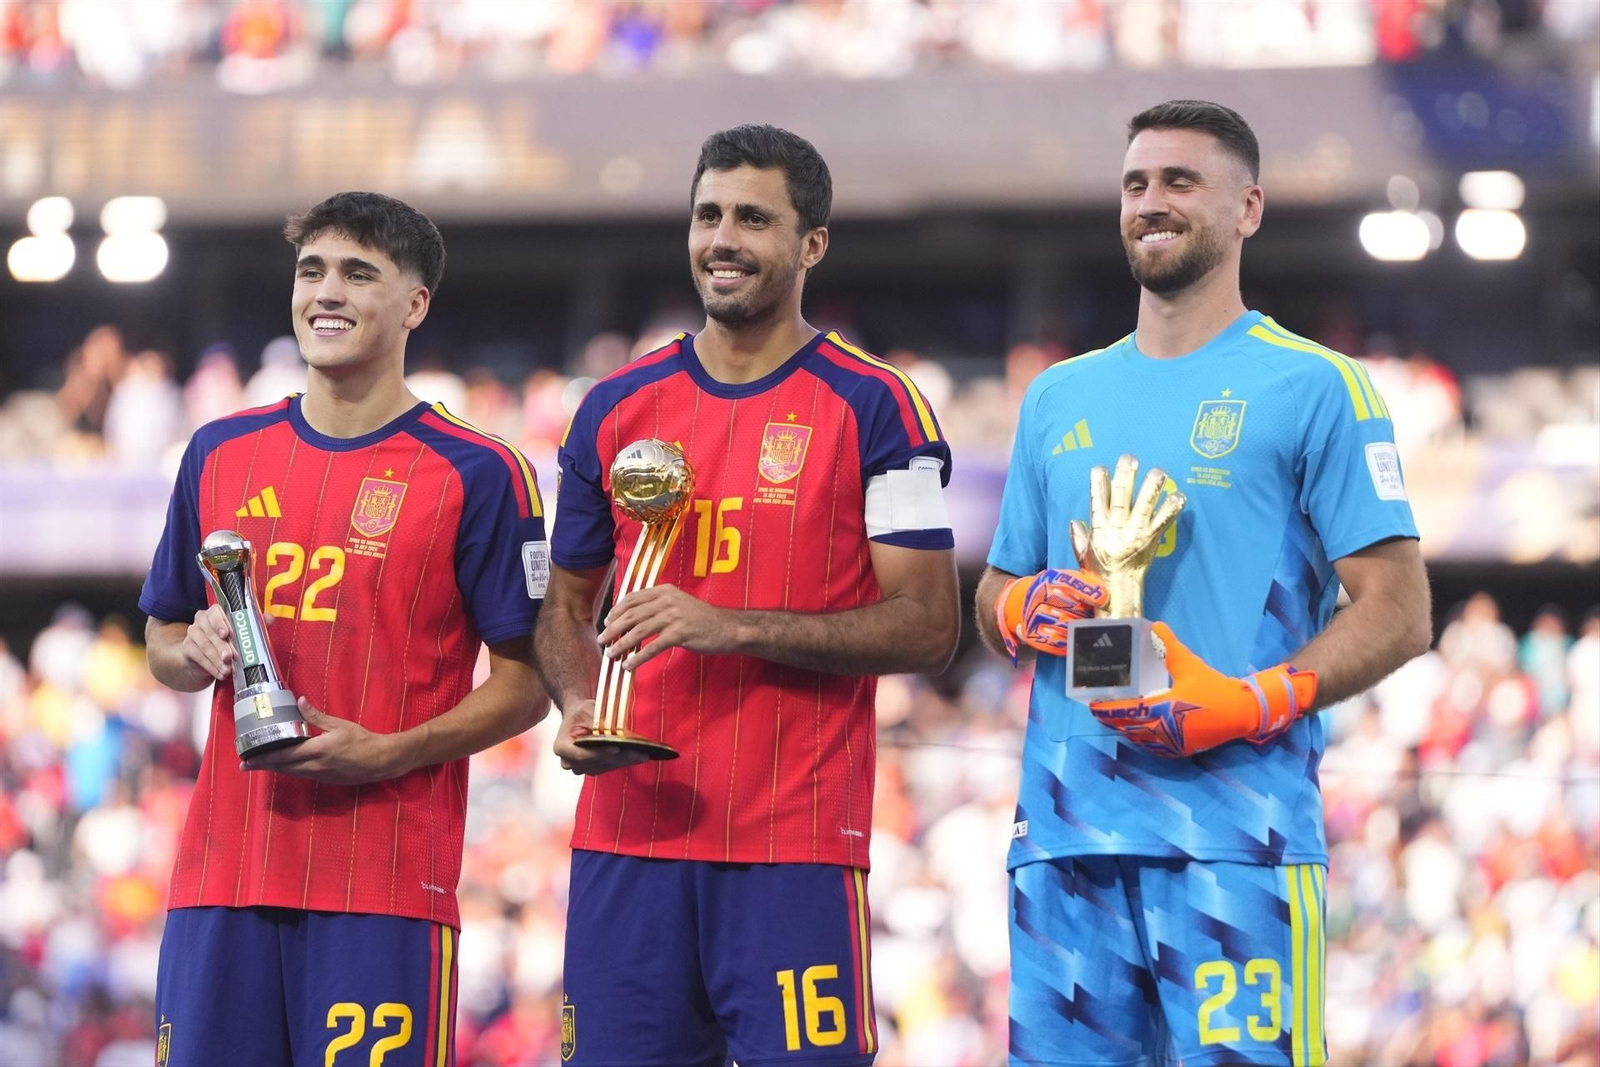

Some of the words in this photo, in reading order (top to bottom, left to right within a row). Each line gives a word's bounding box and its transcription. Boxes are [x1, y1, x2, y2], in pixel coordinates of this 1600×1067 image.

[530, 551, 547, 559] FOOTBAL
[531, 560, 547, 571] UNITE
[693, 497, 744, 577] 16
[264, 542, 346, 622] 22
[1055, 573, 1102, 600] reusch
[235, 611, 255, 663] aramco
[325, 1002, 413, 1067] 22
[776, 964, 847, 1051] 16
[1194, 958, 1282, 1046] 23
